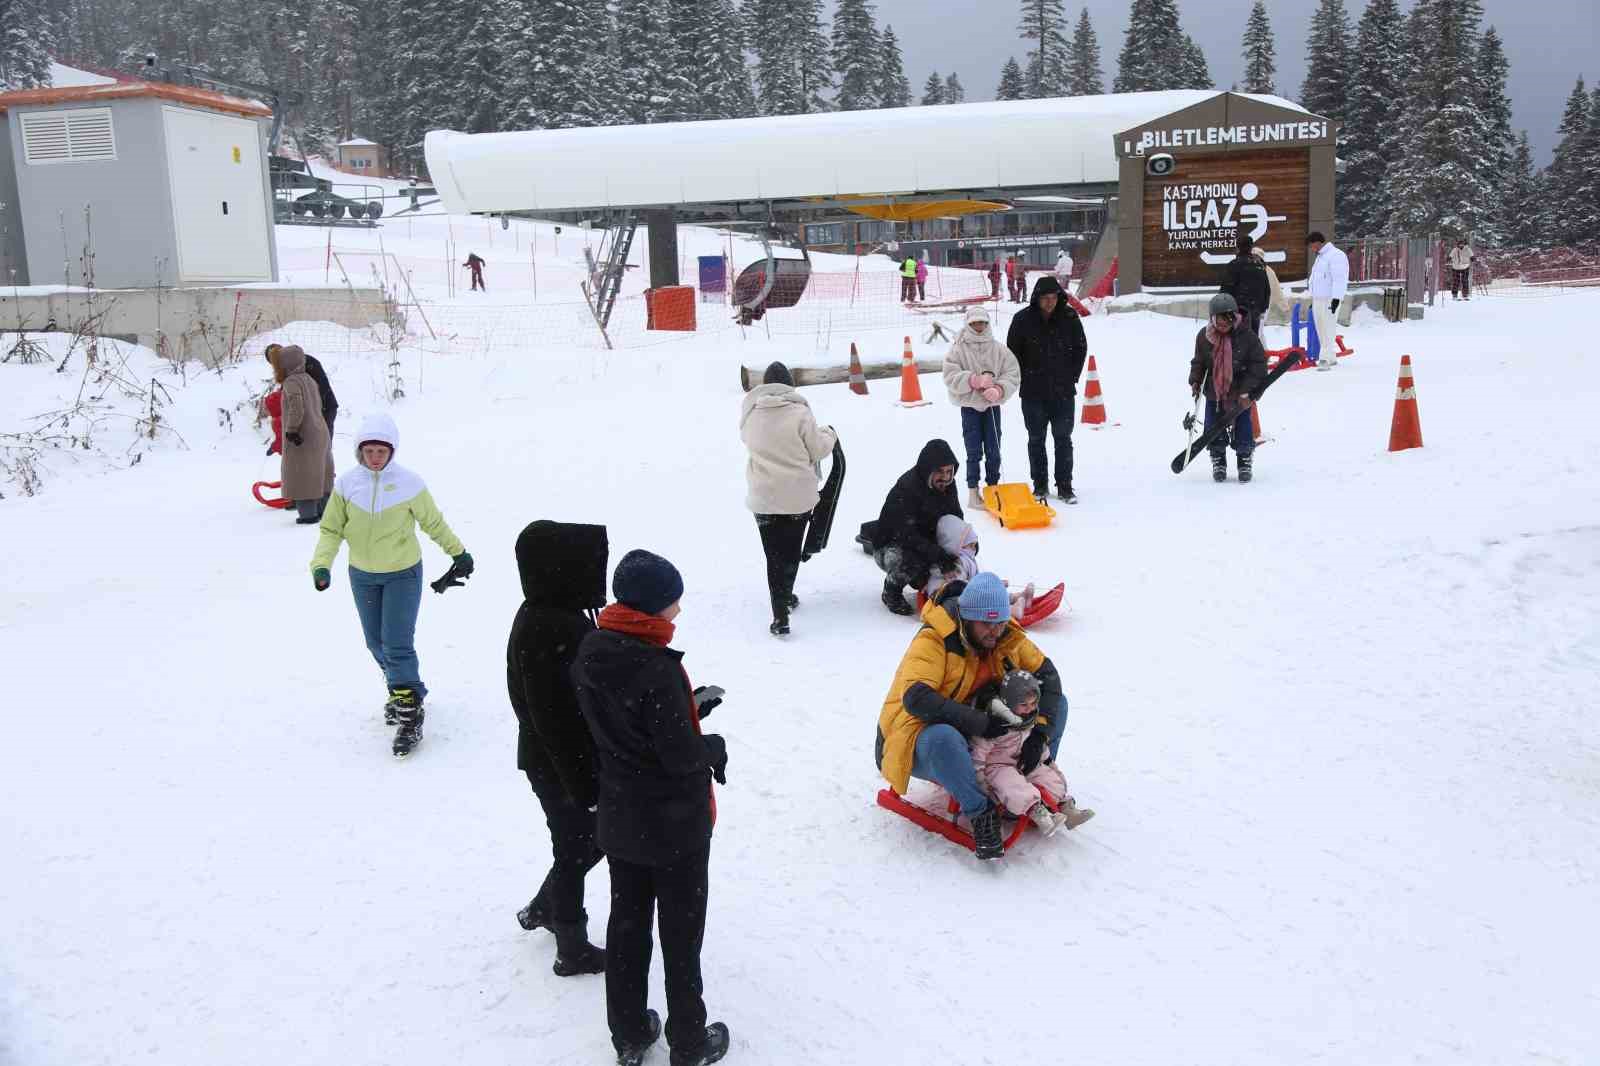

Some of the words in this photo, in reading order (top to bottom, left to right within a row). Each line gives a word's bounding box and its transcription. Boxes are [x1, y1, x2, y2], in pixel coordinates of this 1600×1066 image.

[1163, 183, 1238, 200] KASTAMONU
[1168, 229, 1237, 240] YURDUNTEPE
[1168, 241, 1198, 250] KAYAK
